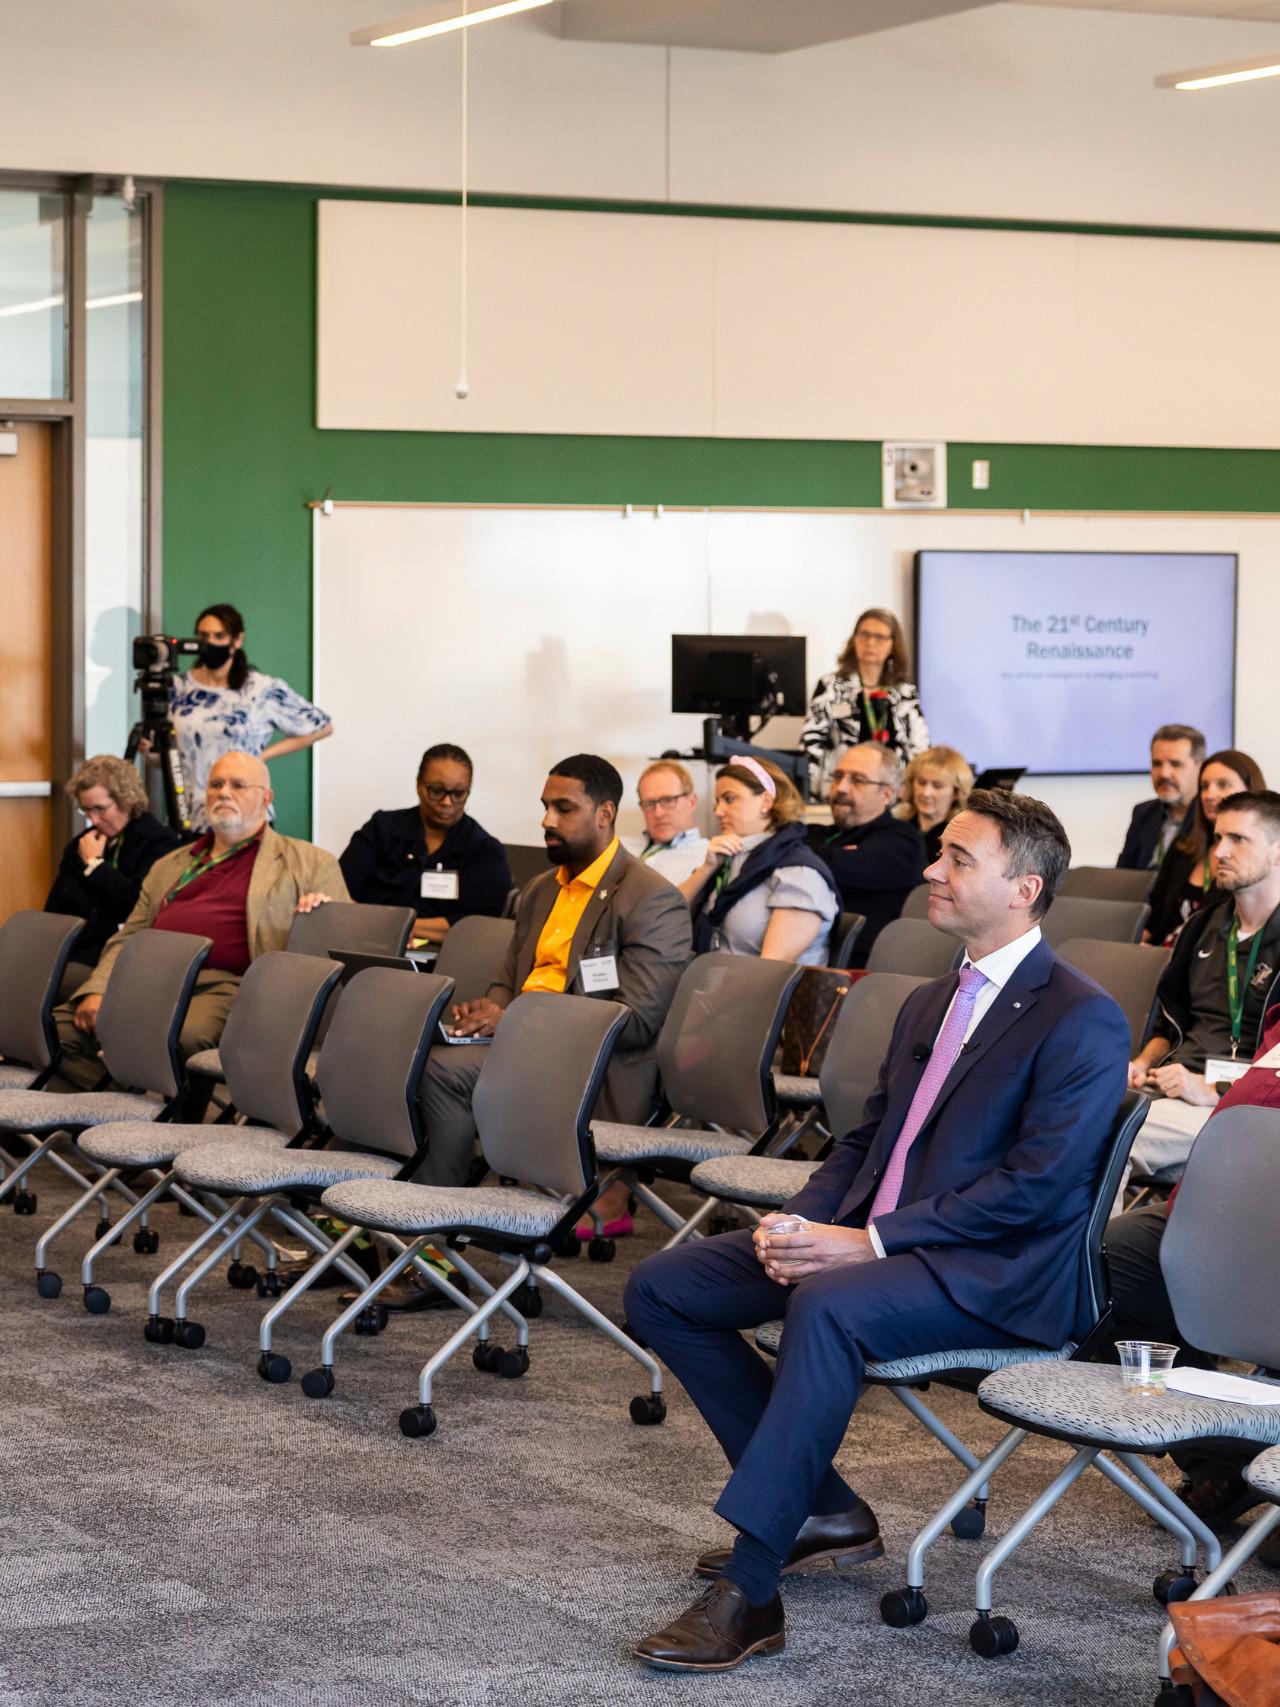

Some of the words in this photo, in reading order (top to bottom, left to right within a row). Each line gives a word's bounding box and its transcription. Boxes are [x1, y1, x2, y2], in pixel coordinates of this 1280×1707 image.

[1011, 614, 1042, 633] The
[1048, 614, 1080, 633] 21st
[1084, 614, 1150, 637] Century
[1027, 641, 1134, 660] Renaissance
